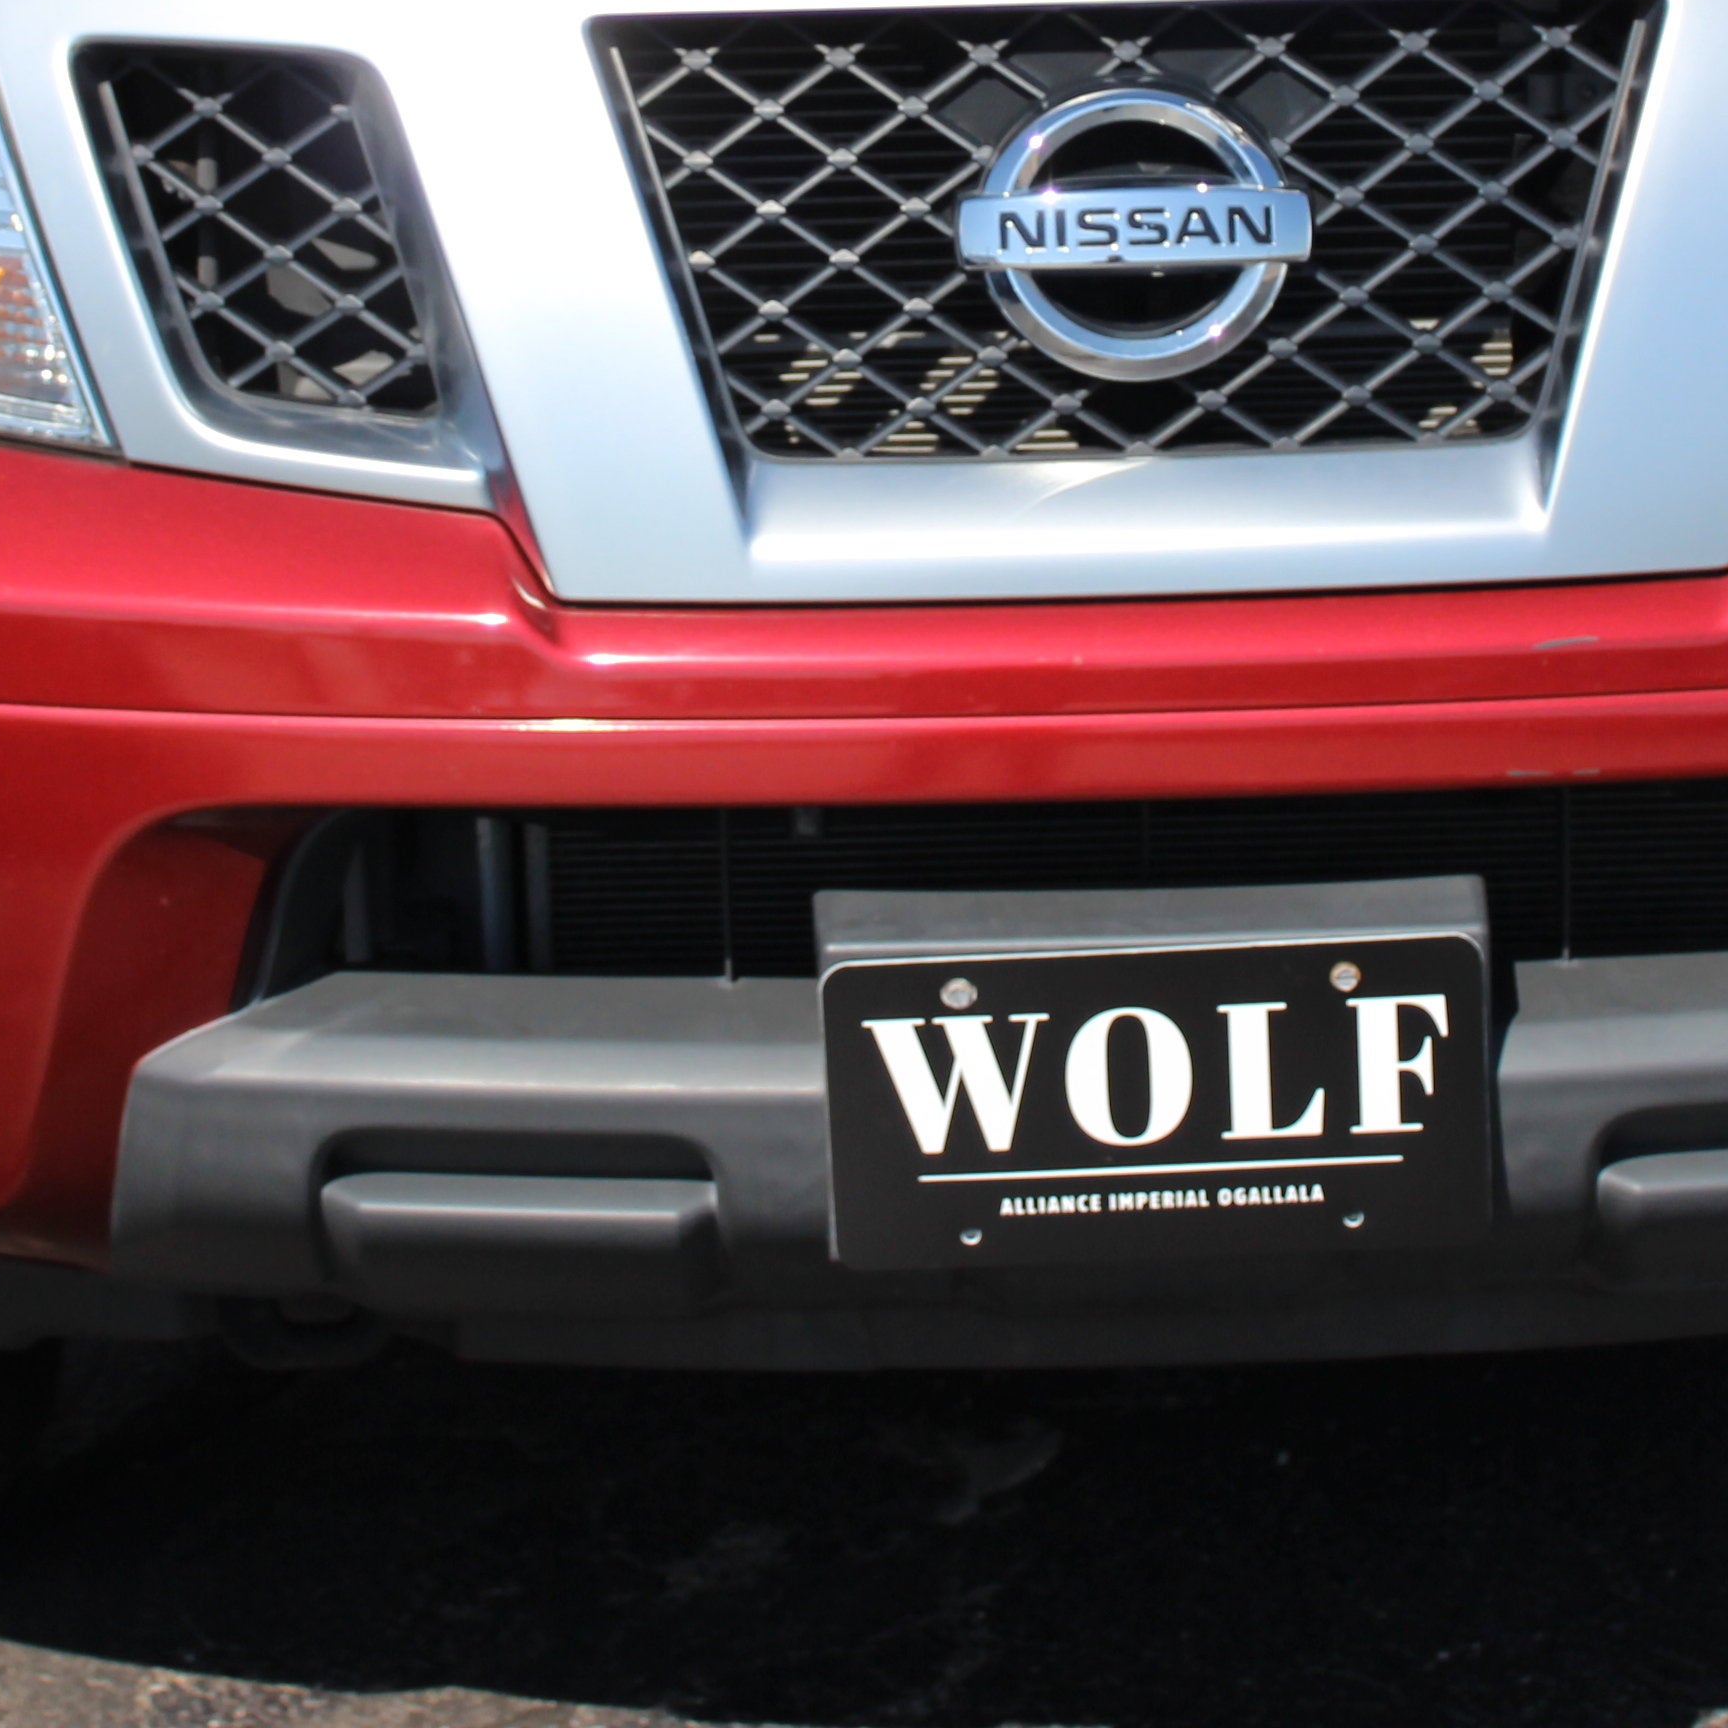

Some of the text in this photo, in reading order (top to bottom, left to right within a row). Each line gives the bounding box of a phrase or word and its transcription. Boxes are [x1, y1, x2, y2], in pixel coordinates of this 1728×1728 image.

[997, 204, 1276, 253] NISSAN
[861, 994, 1449, 1155] WOLF
[999, 1183, 1326, 1217] ALLIANCE IMPERIAL OGALLALA
